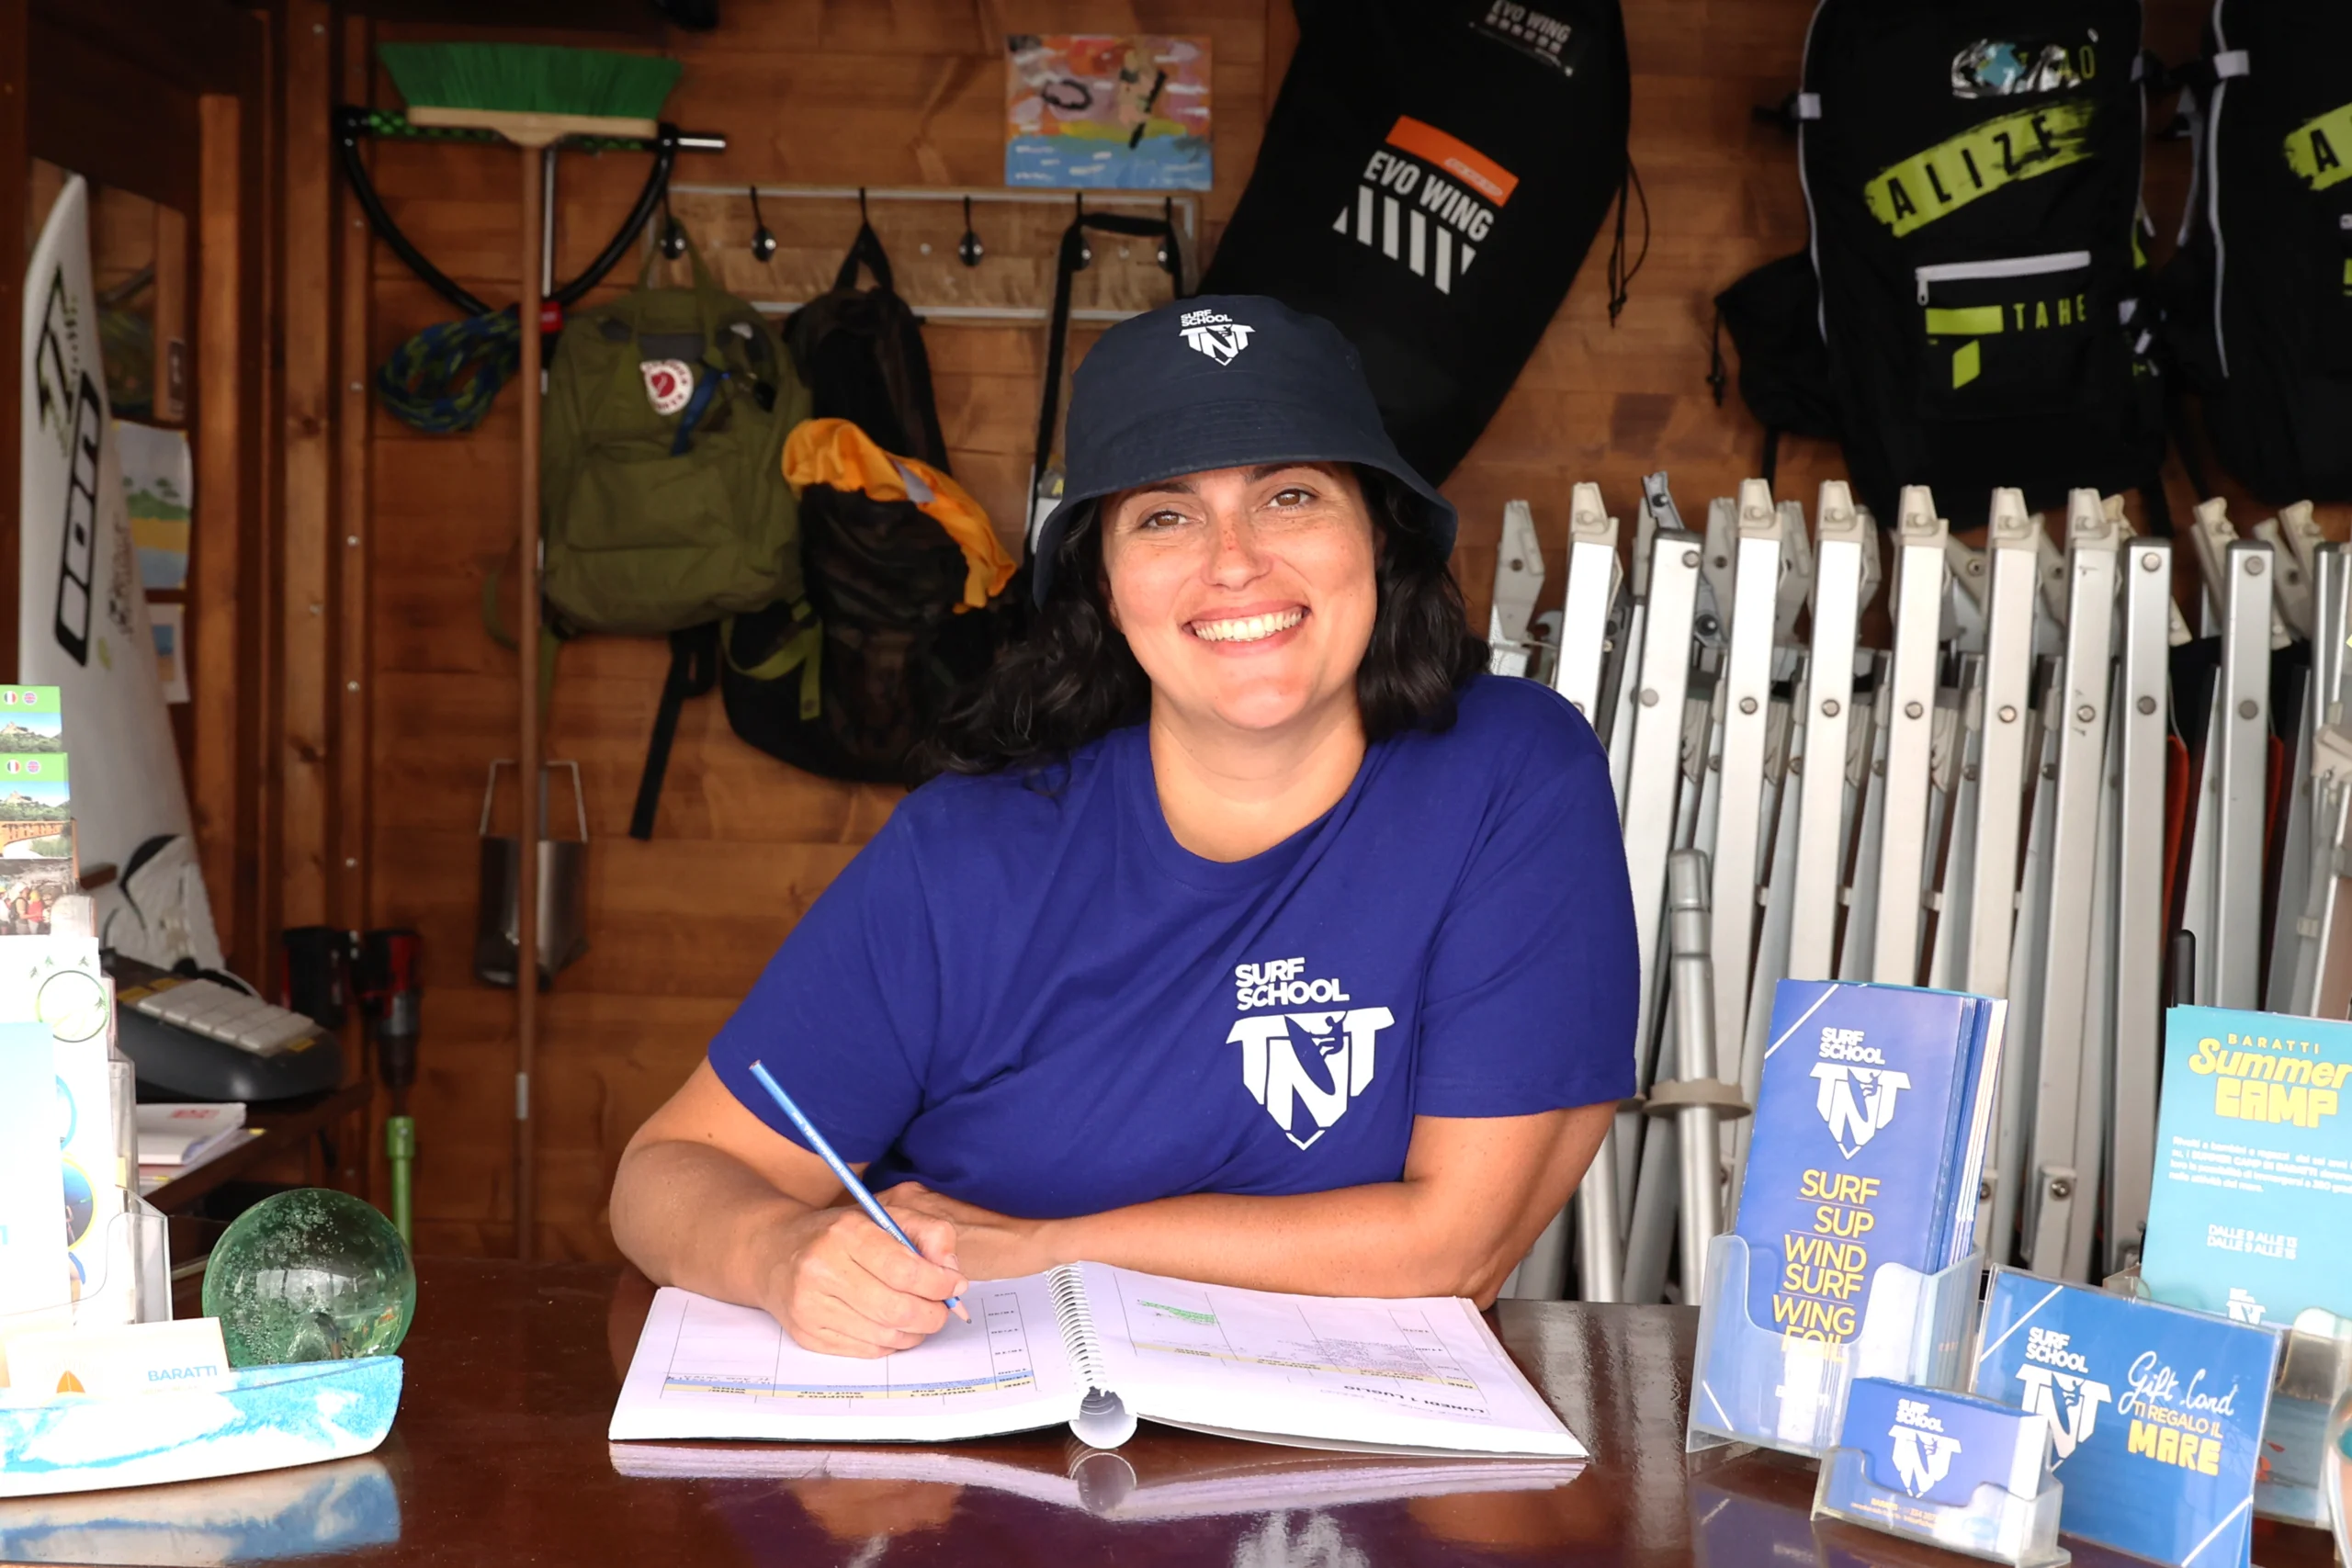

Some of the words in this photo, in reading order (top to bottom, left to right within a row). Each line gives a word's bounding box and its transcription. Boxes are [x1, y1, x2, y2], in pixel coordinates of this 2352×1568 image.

[1526, 12, 1571, 43] WING
[1363, 150, 1421, 196] EVO
[1419, 175, 1495, 243] WING
[1181, 309, 1212, 321] SURF
[1182, 314, 1233, 327] SCHOOL
[2013, 294, 2087, 332] TAHE
[1179, 324, 1256, 360] TNT
[1235, 957, 1306, 988] SURF
[1237, 978, 1350, 1010] SCHOOL
[1821, 1027, 1864, 1045] SURF
[2228, 1033, 2320, 1055] BARATTI
[1818, 1043, 1885, 1065] SCHOOL
[2188, 1038, 2352, 1089] Summer
[1226, 1007, 1395, 1139] TNT
[1809, 1062, 1911, 1148] TNT
[2215, 1077, 2338, 1128] CAMP
[1800, 1168, 1881, 1205] SURF
[1814, 1205, 1874, 1238] SUP
[1784, 1234, 1867, 1273] WIND
[1782, 1264, 1864, 1301] SURF
[1772, 1294, 1856, 1336] WING
[2027, 1326, 2071, 1348] SURF
[147, 1365, 219, 1382] BARATTI
[2025, 1342, 2089, 1373] SCHOOL
[2117, 1350, 2179, 1416] Gift
[1895, 1410, 1944, 1433] SCHOOL
[1897, 1398, 1930, 1417] SURF
[2015, 1363, 2112, 1461] TNT
[2147, 1404, 2210, 1434] REGALO
[2210, 1421, 2223, 1439] IL
[1888, 1425, 1962, 1496] TNT
[2128, 1418, 2222, 1476] MARE
